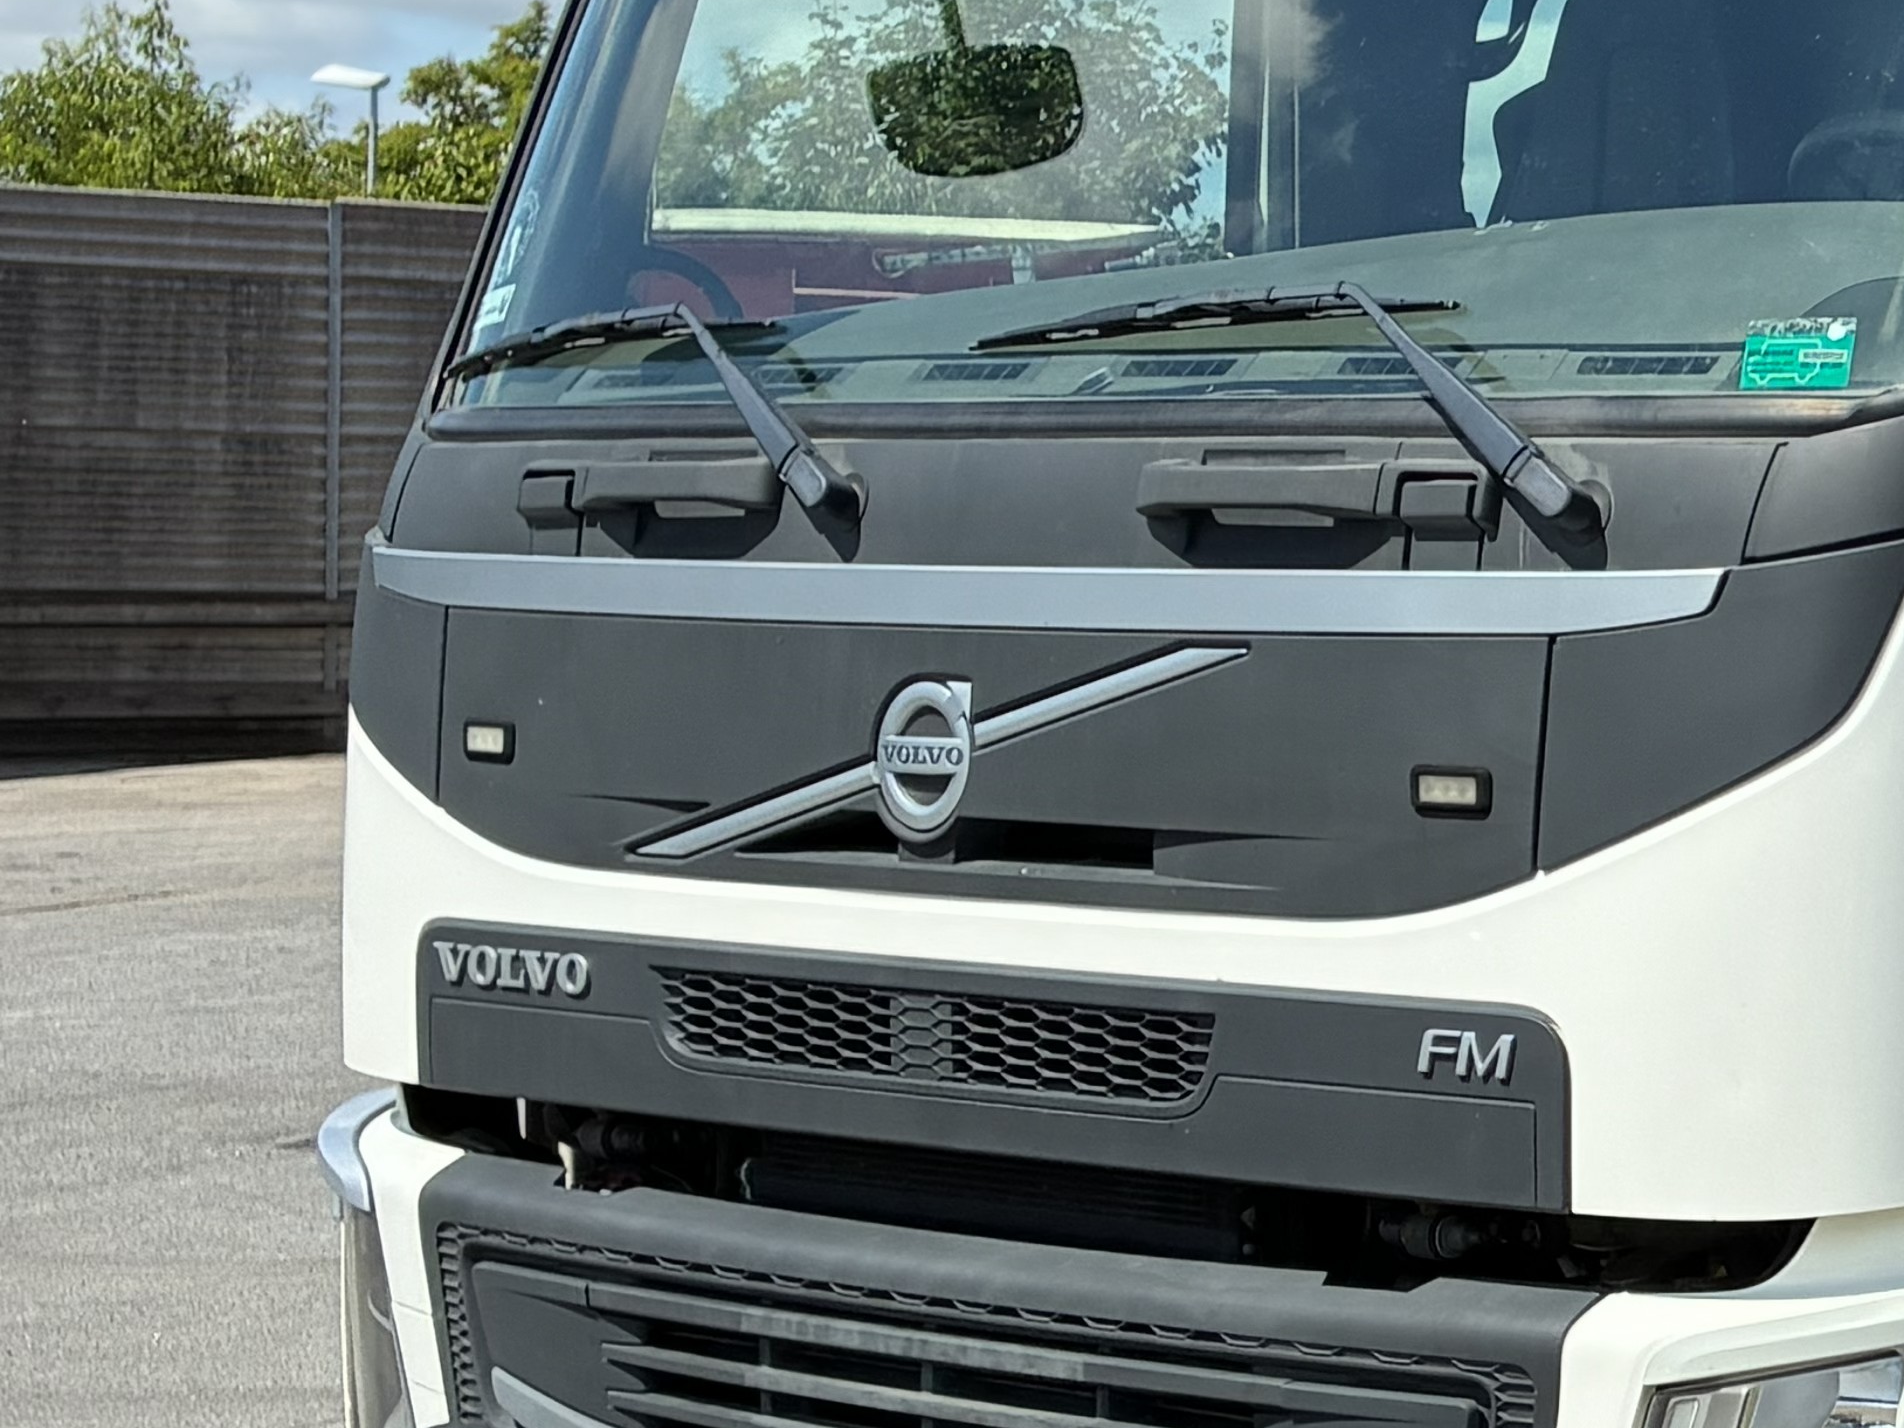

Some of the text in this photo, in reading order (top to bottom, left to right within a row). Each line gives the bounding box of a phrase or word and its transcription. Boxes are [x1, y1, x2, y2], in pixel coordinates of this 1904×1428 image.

[881, 744, 964, 766] VOLVO
[432, 940, 589, 995] VOLVO
[1417, 1028, 1516, 1080] FM
